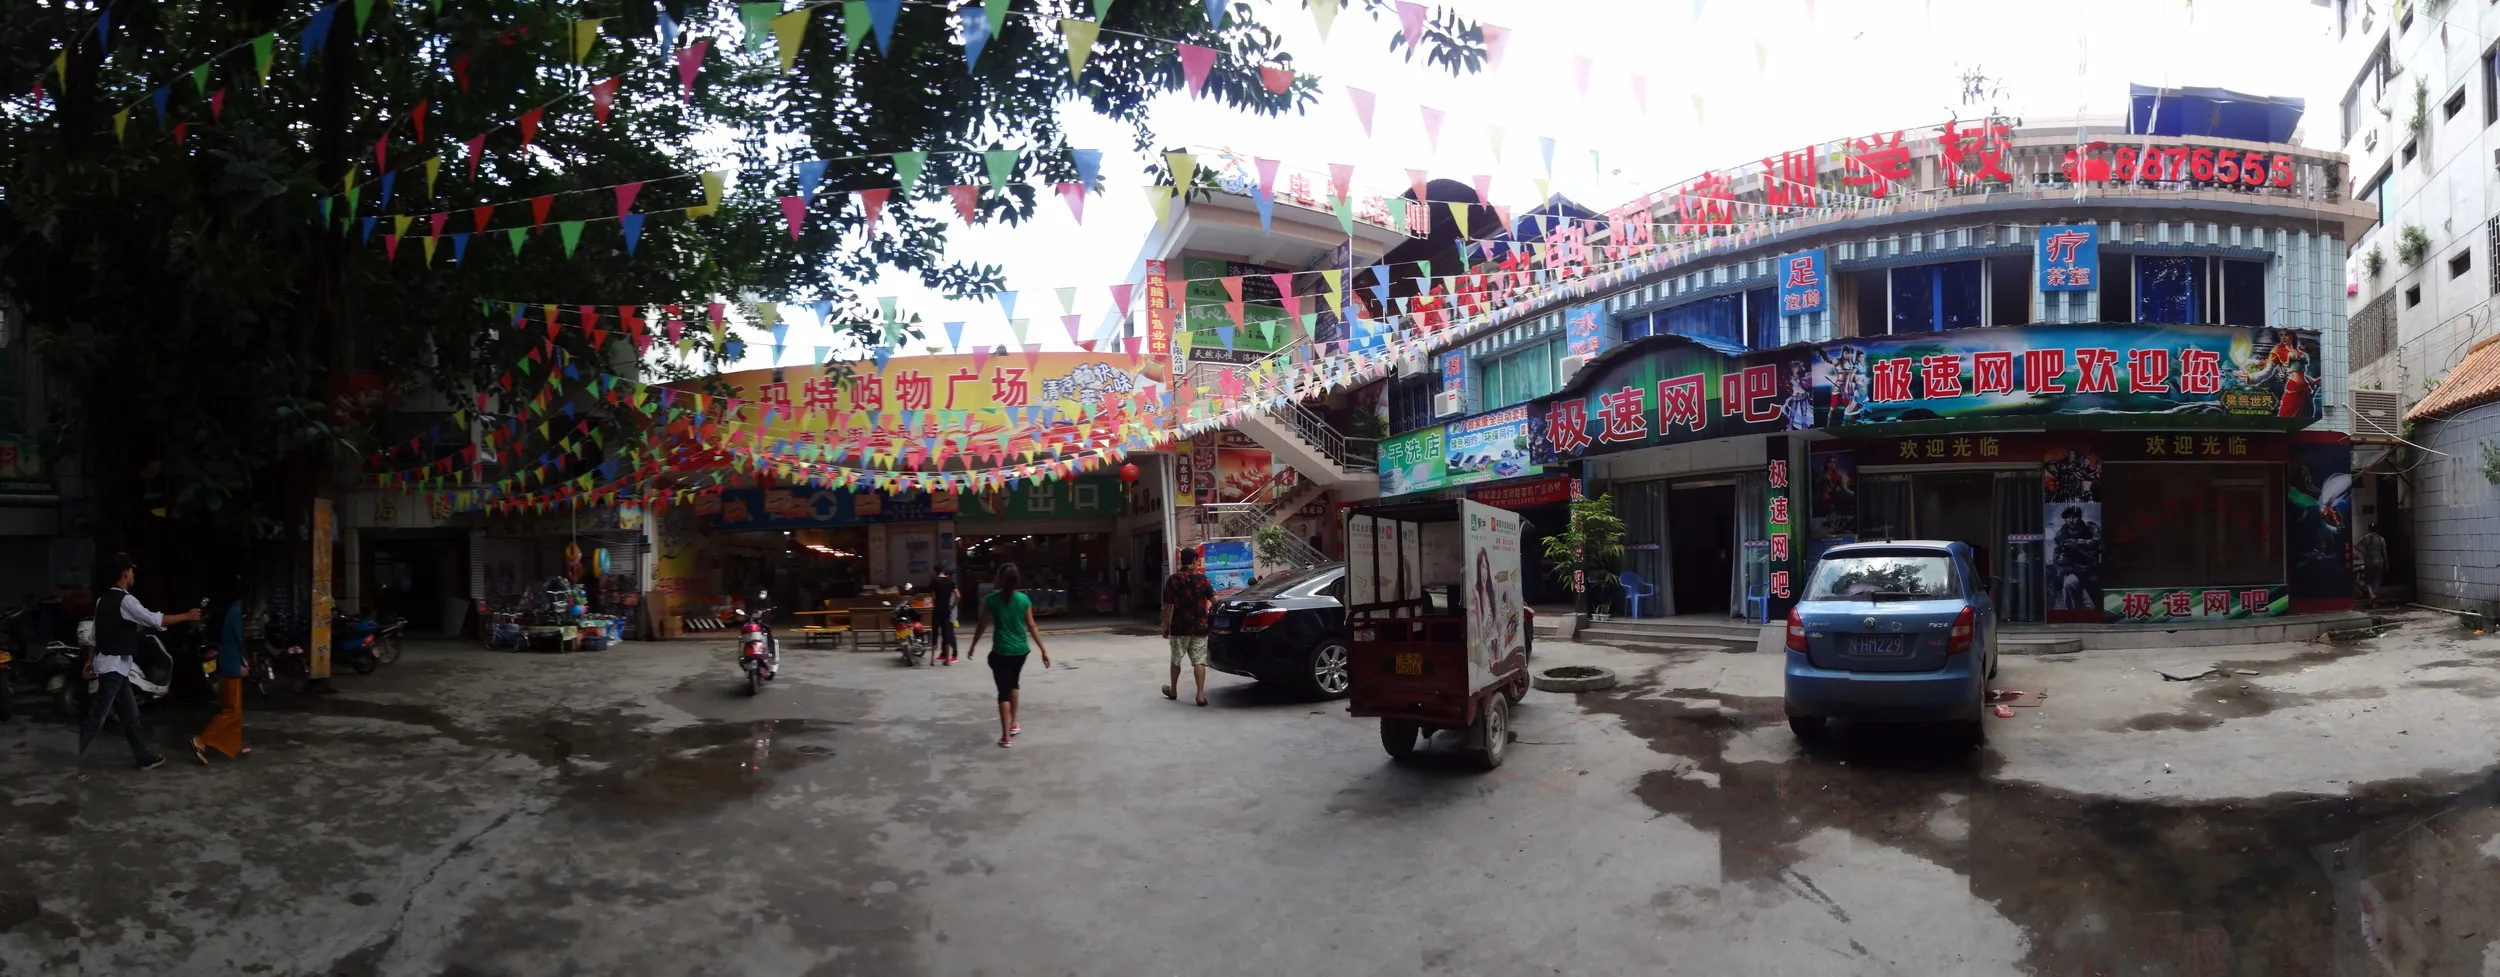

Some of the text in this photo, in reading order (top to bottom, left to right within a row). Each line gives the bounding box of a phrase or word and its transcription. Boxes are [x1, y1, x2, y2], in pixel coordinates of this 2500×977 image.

[2115, 146, 2295, 188] 8876555
[2046, 229, 2090, 263] 疗
[1786, 256, 1818, 288] 足
[1150, 276, 1166, 352] 电脑培营业中
[1873, 348, 2220, 402] 极速网吧欢迎您
[1546, 364, 1782, 453] 极速网吧
[1387, 432, 1441, 468] 干洗店
[1900, 436, 2000, 458] 欢迎光临
[2146, 435, 2247, 456] 欢迎光临
[1028, 483, 1099, 512] 出口
[1769, 460, 1790, 598] 极速网吧
[2122, 589, 2270, 619] 极速网吧
